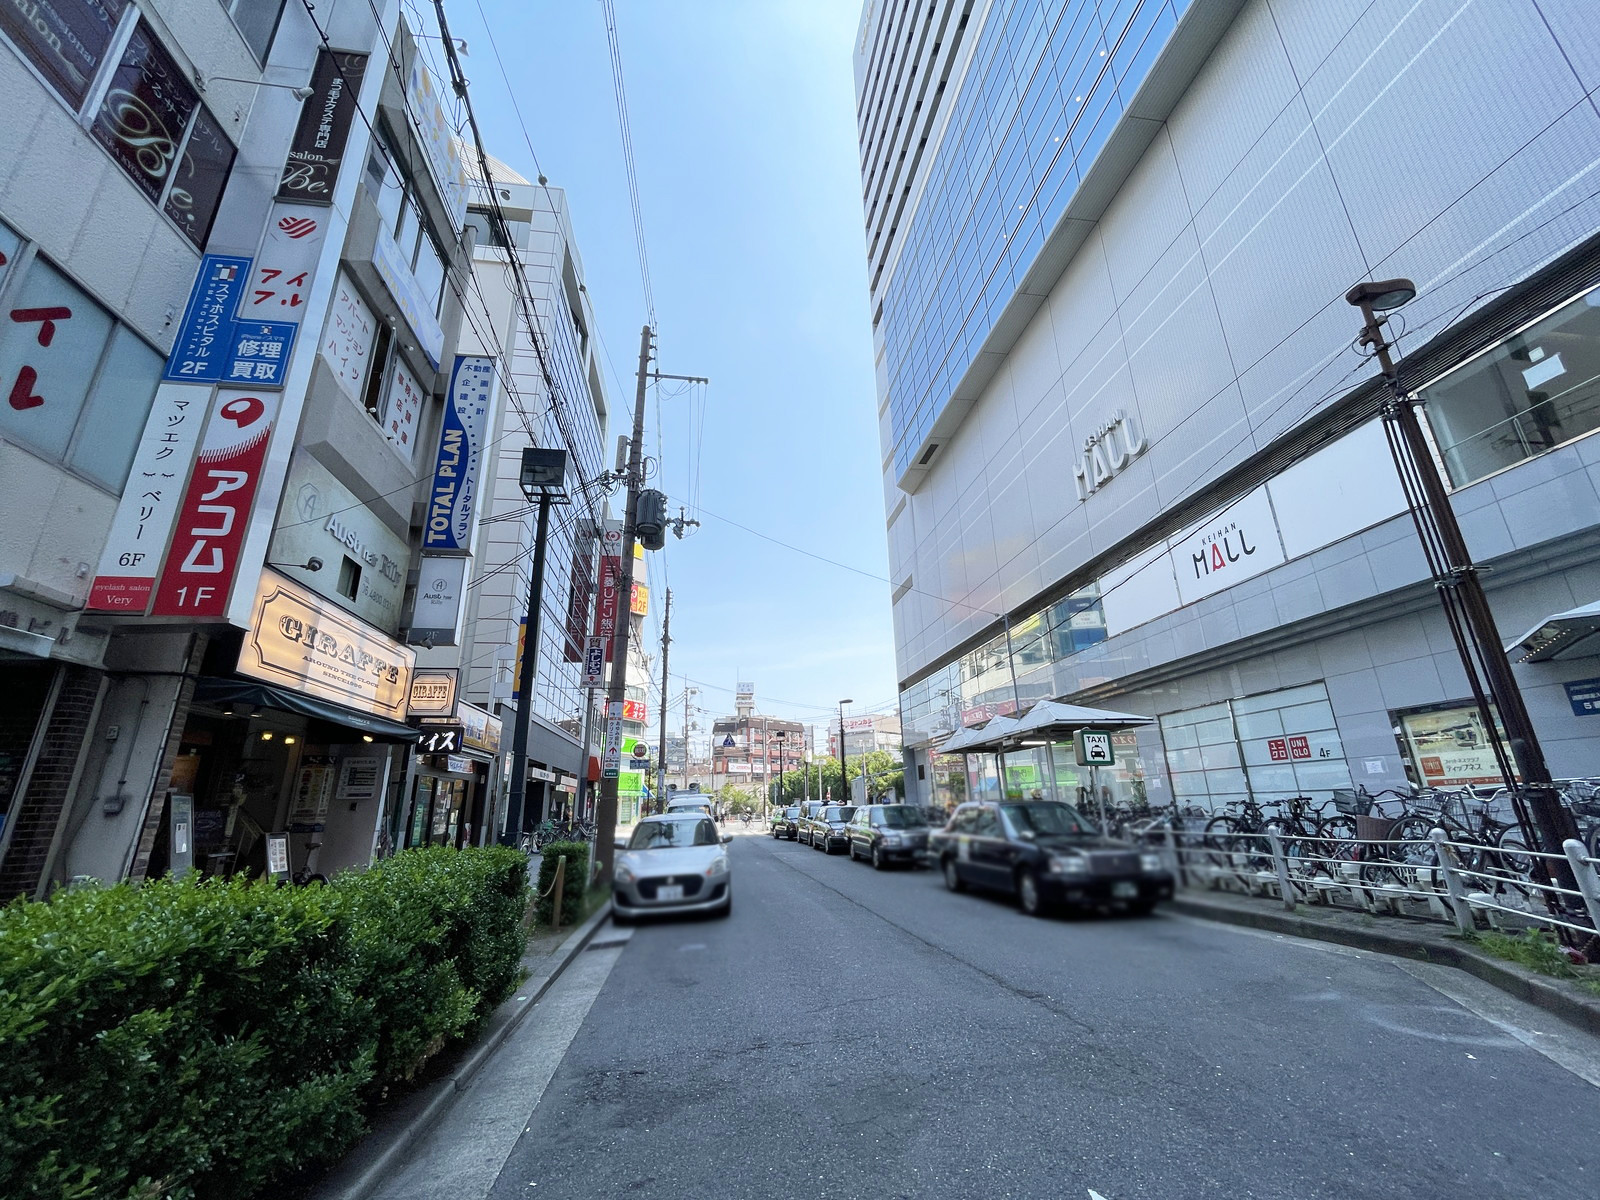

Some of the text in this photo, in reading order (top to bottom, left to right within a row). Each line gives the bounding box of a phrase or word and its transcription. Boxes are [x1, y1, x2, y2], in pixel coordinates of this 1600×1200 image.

[314, 77, 344, 149] まつ毛エクステ専門店
[289, 150, 324, 162] salon
[195, 283, 229, 358] スマホスピタル
[237, 339, 282, 359] 修理
[180, 361, 208, 375] 2F
[229, 361, 277, 380] 買取
[464, 364, 491, 374] 不動産
[1072, 417, 1148, 502] MALL
[136, 400, 190, 540] マツエク ベリー
[427, 428, 463, 544] TOTAL PLAN
[456, 476, 474, 541] トータルプラン
[180, 469, 249, 574] アコム
[1201, 522, 1237, 546] KEIHAN
[118, 552, 146, 567] 6F
[1192, 529, 1256, 579] MALL
[95, 583, 151, 593] eyelash salon
[106, 594, 133, 606] Very
[176, 586, 216, 607] 1F
[638, 600, 647, 613] 2F
[426, 631, 440, 640] 2F
[589, 637, 602, 648] 質
[278, 614, 399, 684] GIRAFFE
[589, 649, 601, 675] よしむら
[302, 655, 379, 688] AROUND THE CLOCK
[412, 685, 448, 699] GIRAFFE
[633, 702, 644, 711] カラ
[632, 710, 643, 719] オケ
[607, 721, 615, 747] クリニック
[1086, 735, 1106, 744] TAXI
[1270, 742, 1284, 750] ユニ
[1291, 739, 1306, 748] UNI
[1272, 750, 1286, 759] クロ
[1293, 747, 1309, 757] QLO
[1319, 748, 1331, 758] 4F
